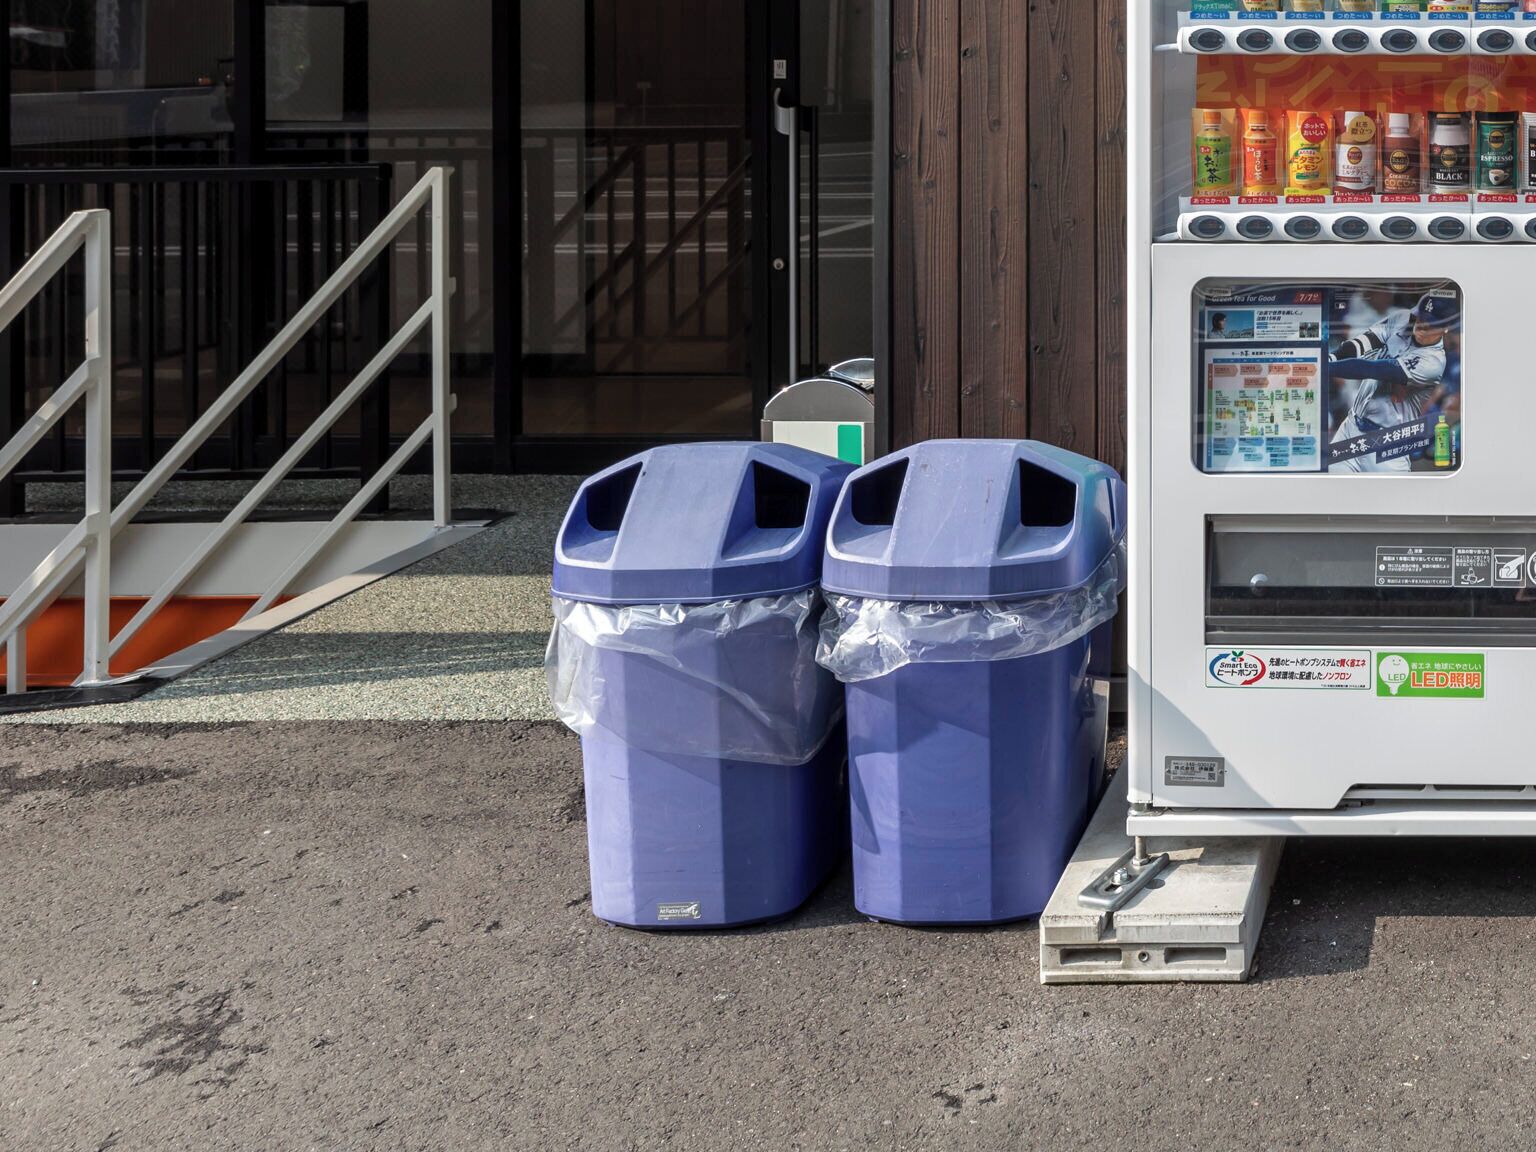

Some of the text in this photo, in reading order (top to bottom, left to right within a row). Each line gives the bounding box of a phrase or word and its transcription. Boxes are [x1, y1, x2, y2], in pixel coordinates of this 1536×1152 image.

[1303, 129, 1326, 137] おいしい
[1292, 155, 1323, 164] ビタミン
[1480, 154, 1513, 162] ESPRESSO
[1254, 150, 1263, 182] ほうじ茶
[1435, 172, 1463, 181] BLACK
[1384, 178, 1416, 186] COCOA
[1246, 294, 1257, 302] for
[1258, 294, 1277, 302] Good
[1382, 423, 1420, 444] 大谷翔平
[1220, 661, 1242, 669] Smart
[1268, 657, 1366, 668] 先進のヒートポンプシステムで賢く省エネ
[1410, 662, 1482, 671] 省エネ 地球にやさしい
[1217, 668, 1258, 677] ヒートポンプ
[1268, 670, 1352, 681] 地球環境に配慮したノンフロン
[1387, 673, 1406, 682] LED
[1410, 672, 1481, 688] LED照明
